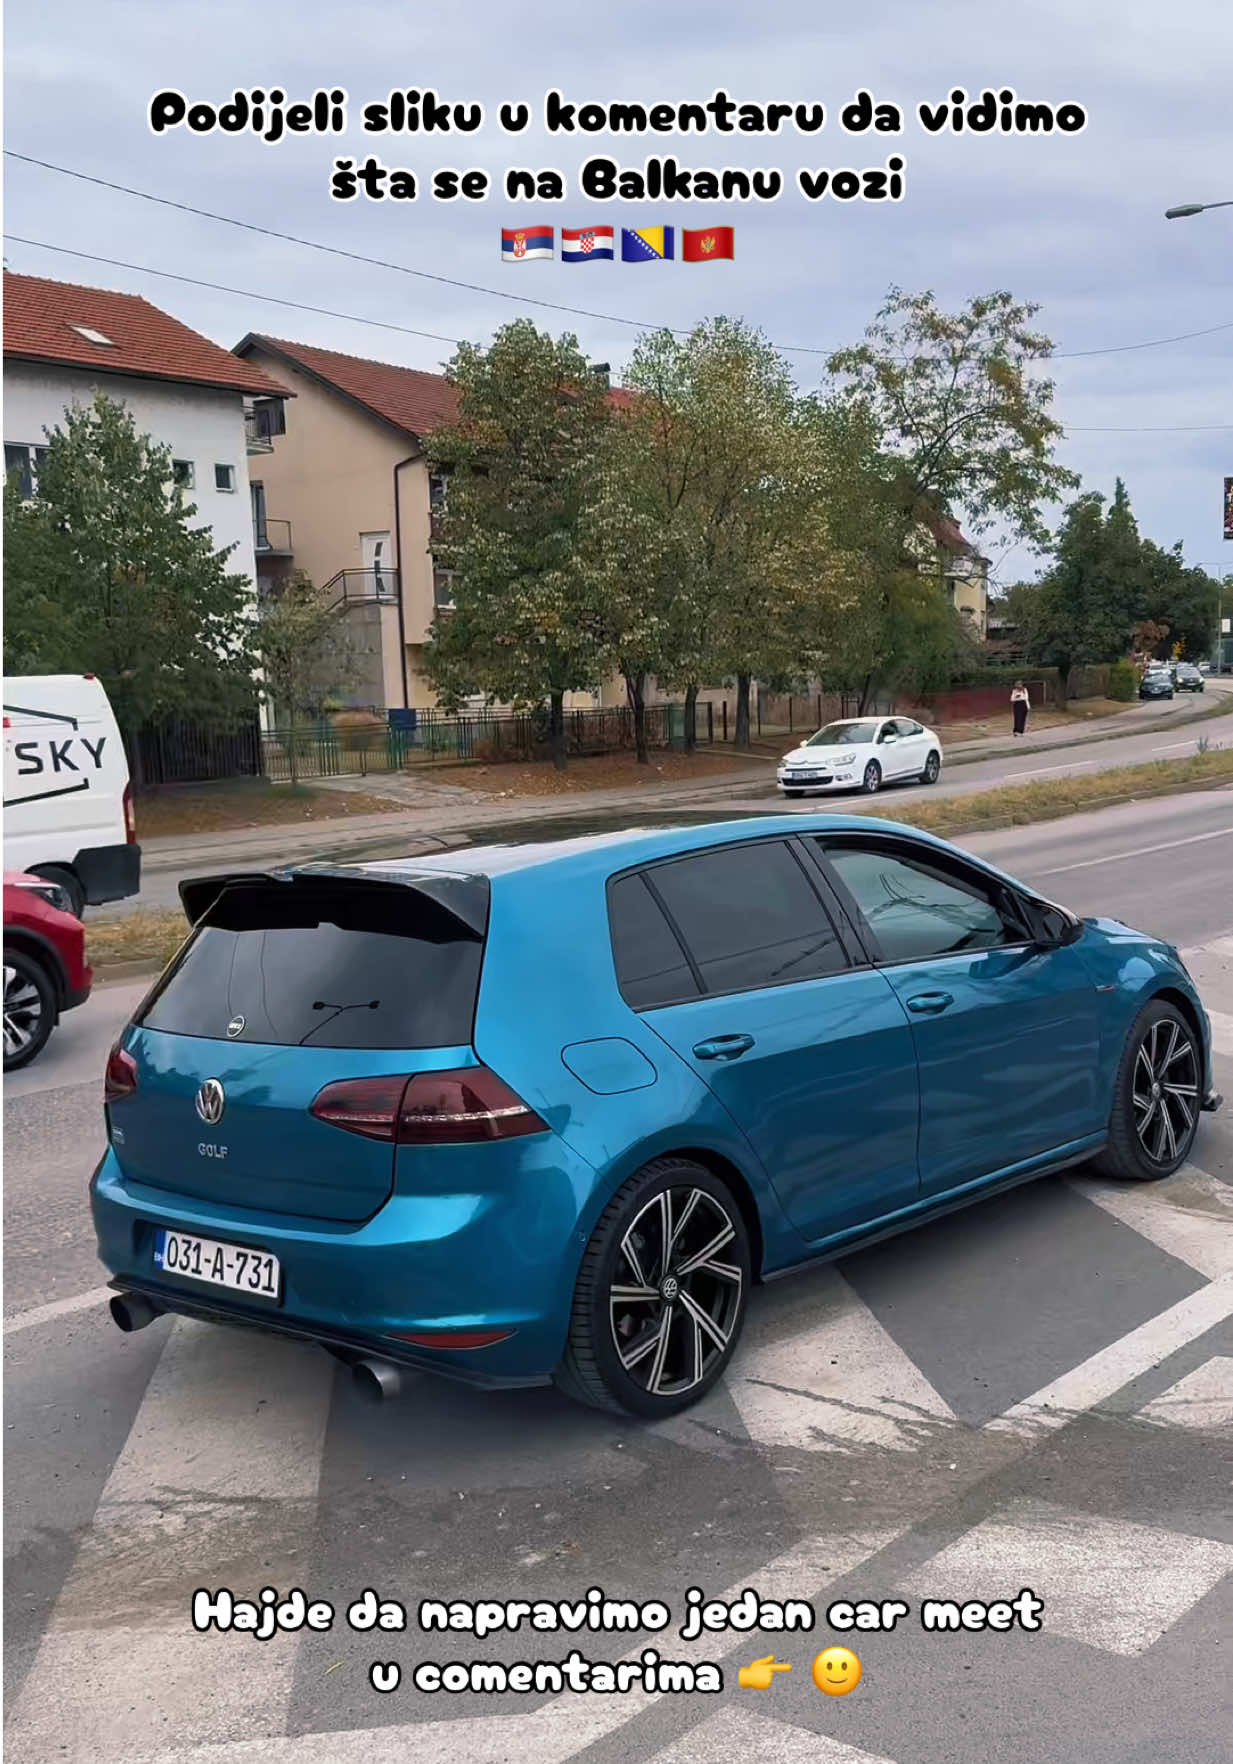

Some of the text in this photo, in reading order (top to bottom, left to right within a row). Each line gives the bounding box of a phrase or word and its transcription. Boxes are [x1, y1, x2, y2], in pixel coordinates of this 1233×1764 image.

[14, 736, 107, 775] SKY
[197, 1142, 229, 1159] GOLF
[166, 1236, 276, 1293] 031-A-731
